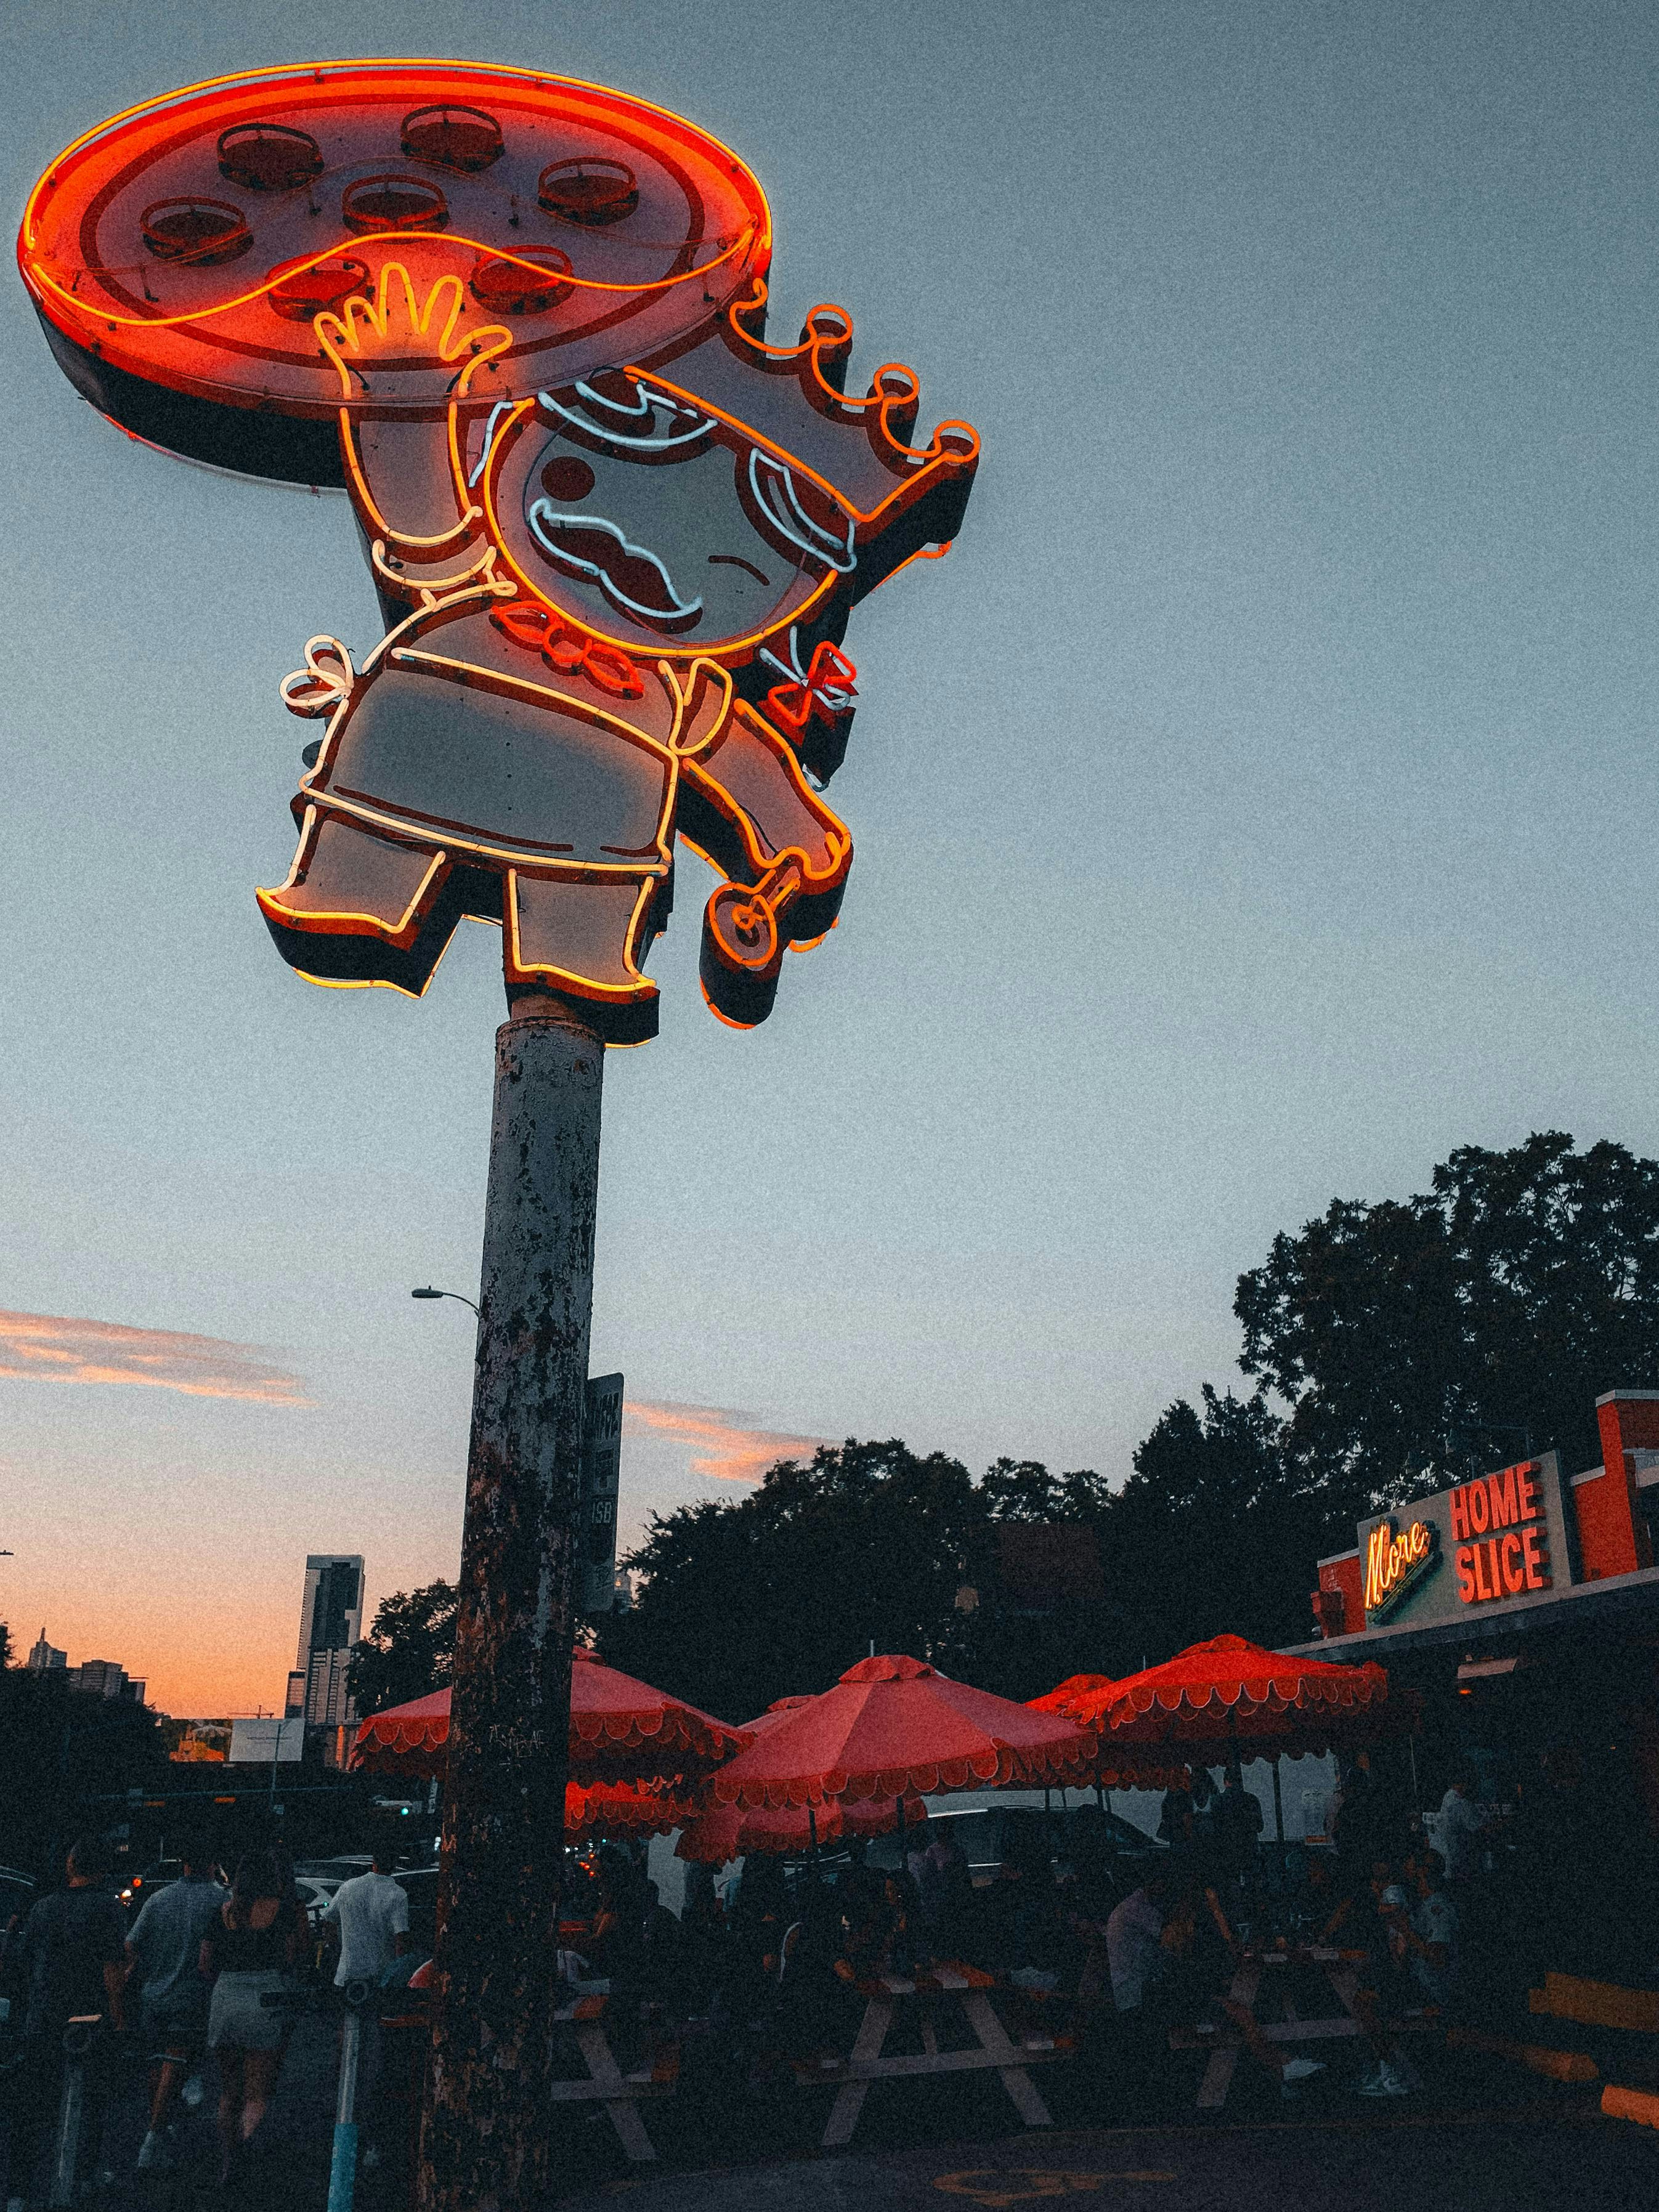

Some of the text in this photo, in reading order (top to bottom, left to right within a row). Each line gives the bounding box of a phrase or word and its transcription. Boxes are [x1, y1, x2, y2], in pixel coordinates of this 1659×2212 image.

[1449, 1461, 1537, 1541] HOME
[1365, 1521, 1430, 1610] More
[1455, 1526, 1544, 1603] SLICE
